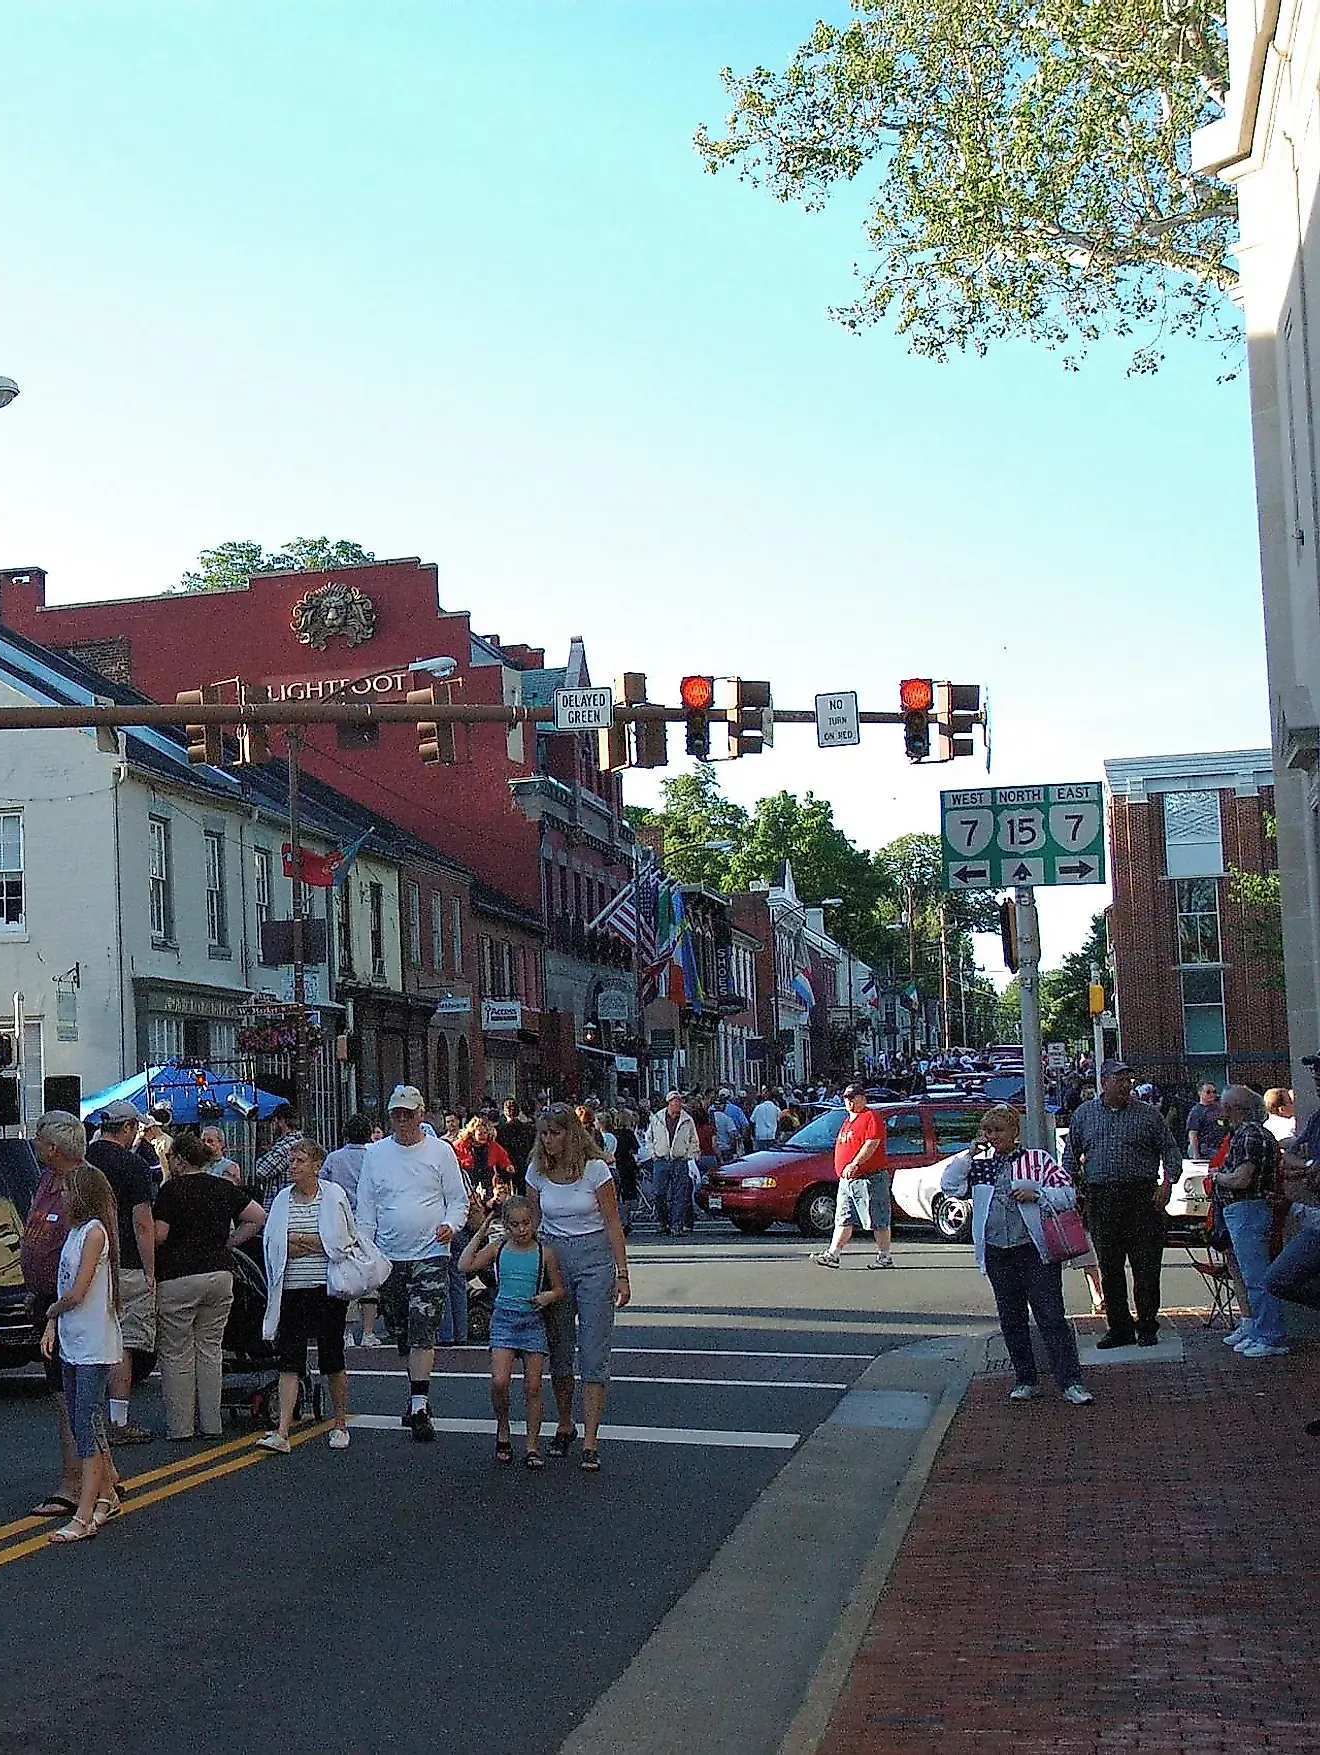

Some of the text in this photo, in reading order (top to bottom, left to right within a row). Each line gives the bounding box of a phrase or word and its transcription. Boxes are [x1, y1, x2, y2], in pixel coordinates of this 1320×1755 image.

[562, 693, 606, 708] DELAYED
[829, 699, 843, 710] NO
[568, 709, 601, 724] GREEN
[828, 716, 847, 726] TURN
[824, 730, 853, 741] ON RED
[951, 792, 985, 805] WEST
[999, 789, 1041, 803] NORTH
[1057, 786, 1091, 800] EAST
[960, 819, 979, 847] 7
[1006, 817, 1037, 845] 15
[1064, 814, 1084, 841] 7
[717, 948, 728, 996] SHOES
